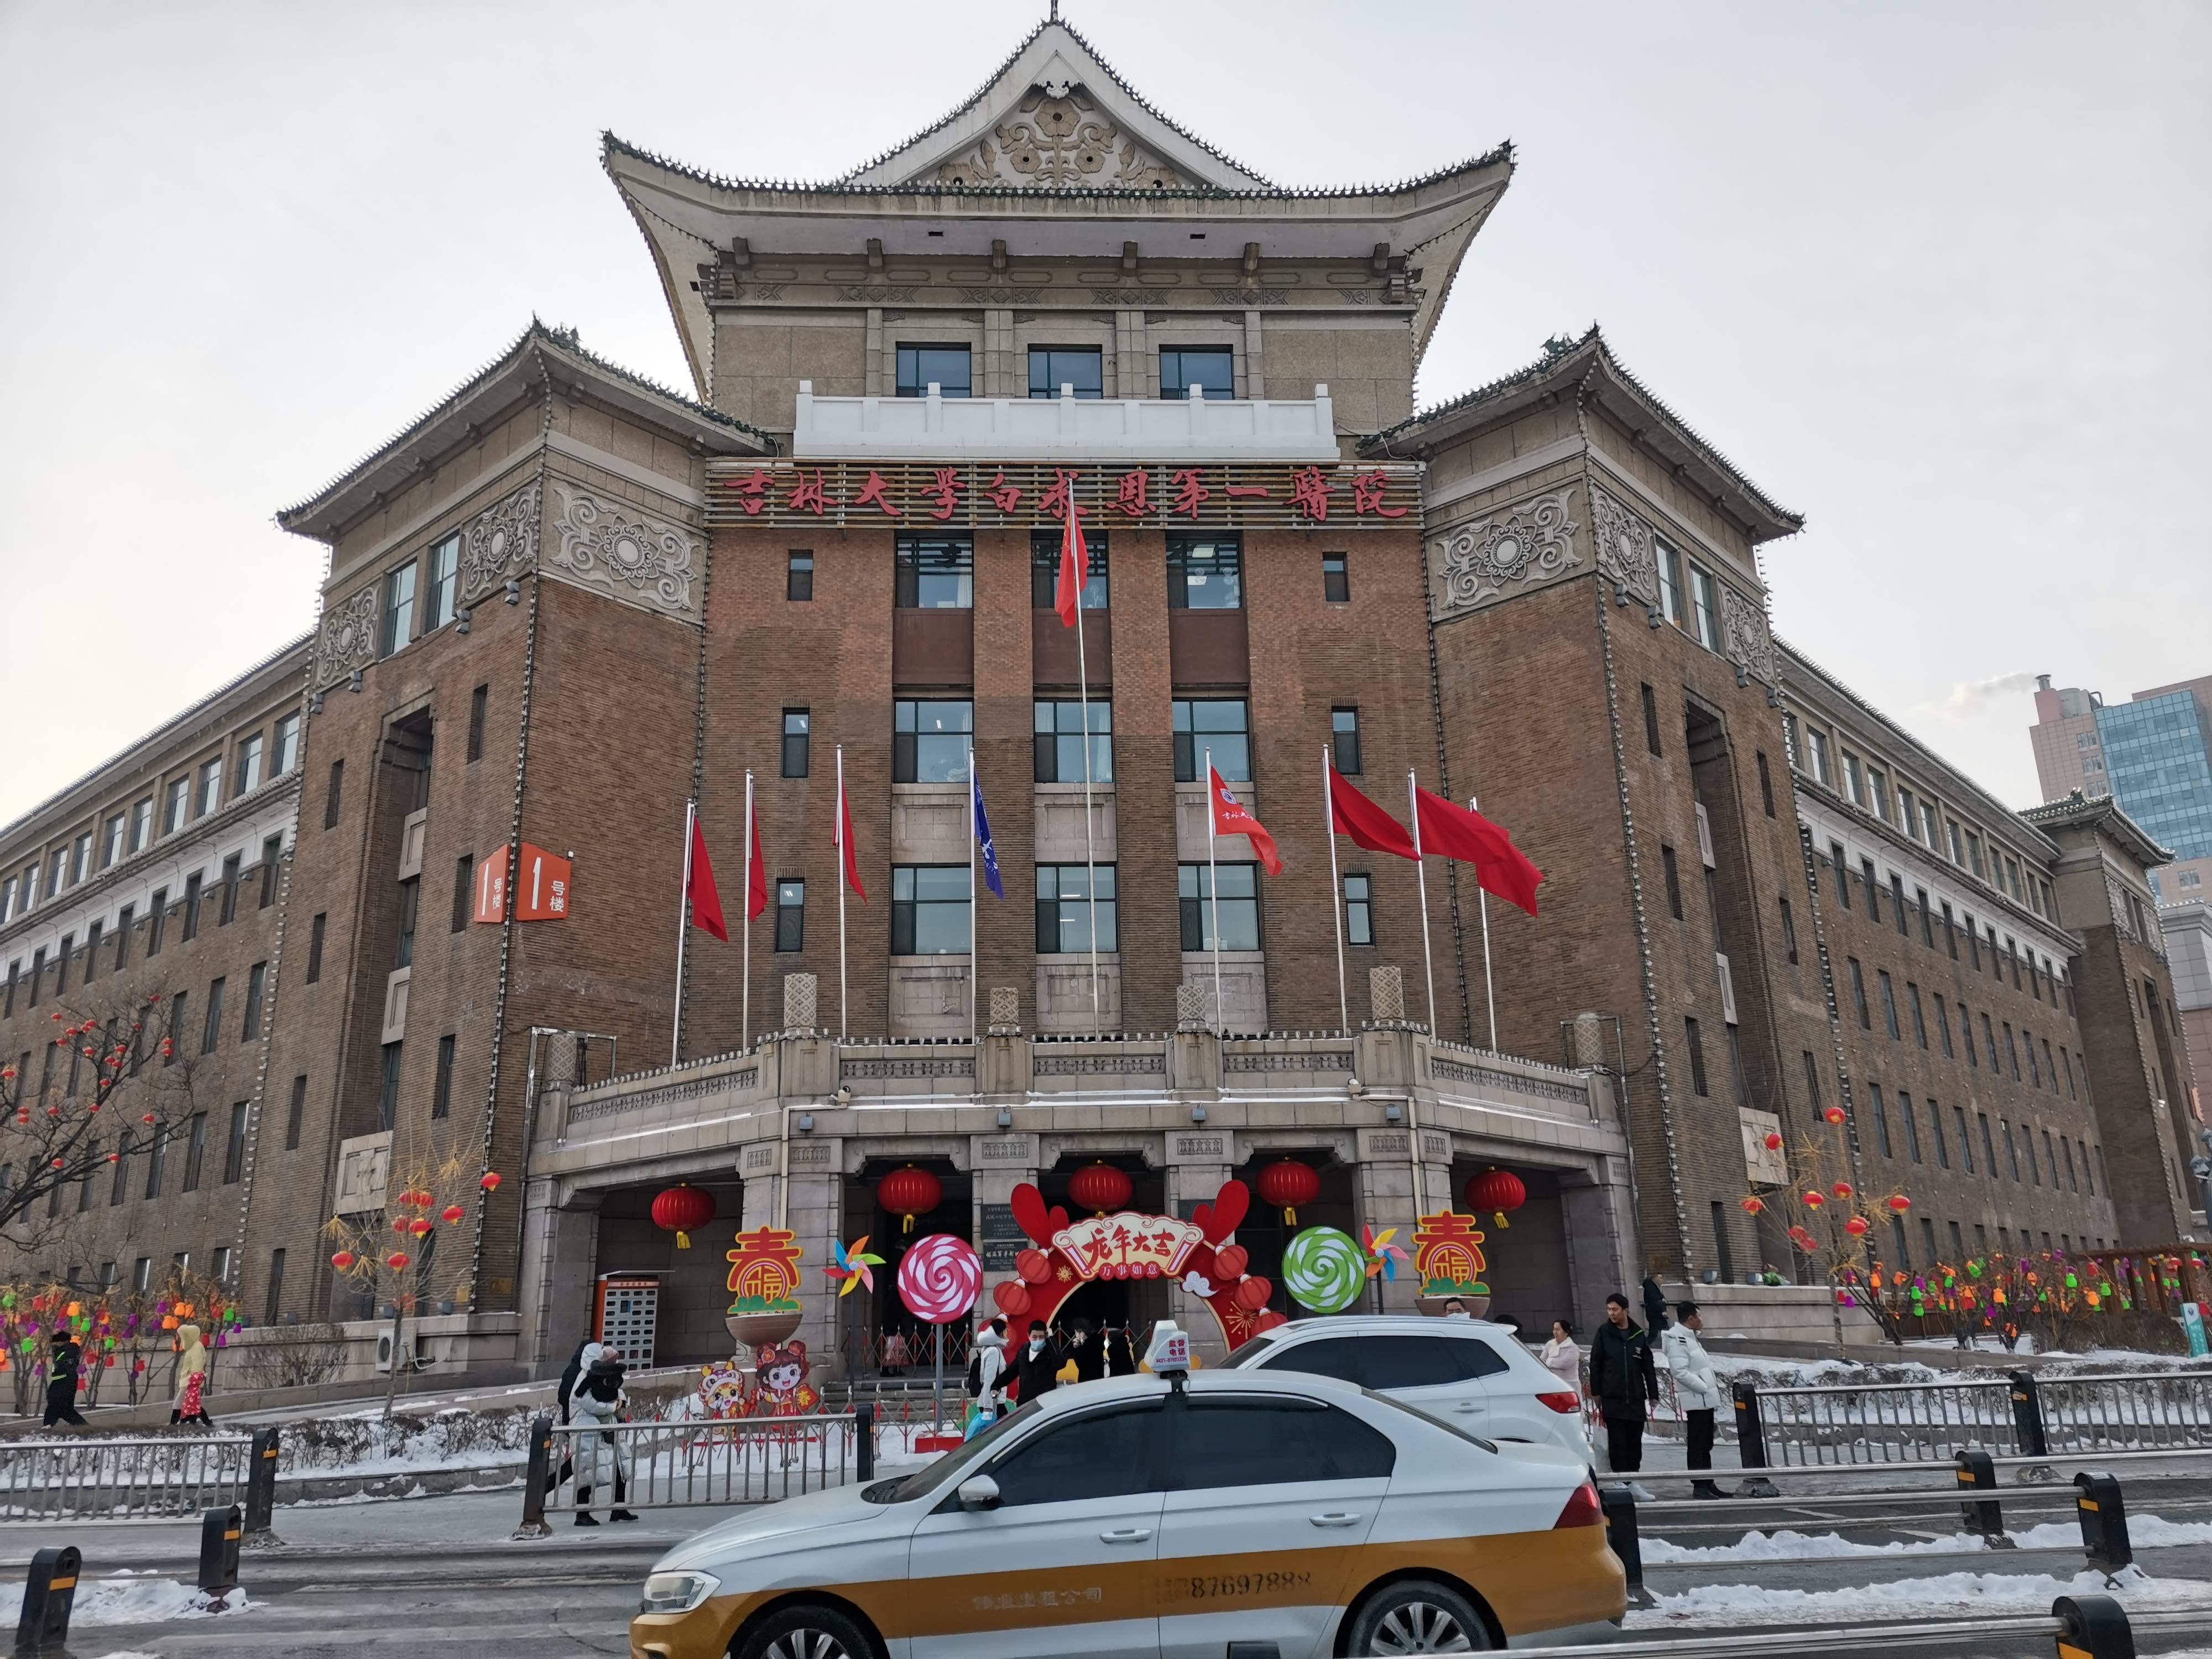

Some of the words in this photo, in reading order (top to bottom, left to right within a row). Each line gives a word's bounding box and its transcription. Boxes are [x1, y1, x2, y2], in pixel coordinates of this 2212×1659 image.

[550, 880, 565, 912] 号楼
[1081, 1224, 1176, 1270] 龙年大吉
[1102, 1260, 1157, 1275] 万事如意
[796, 1391, 811, 1406] 春
